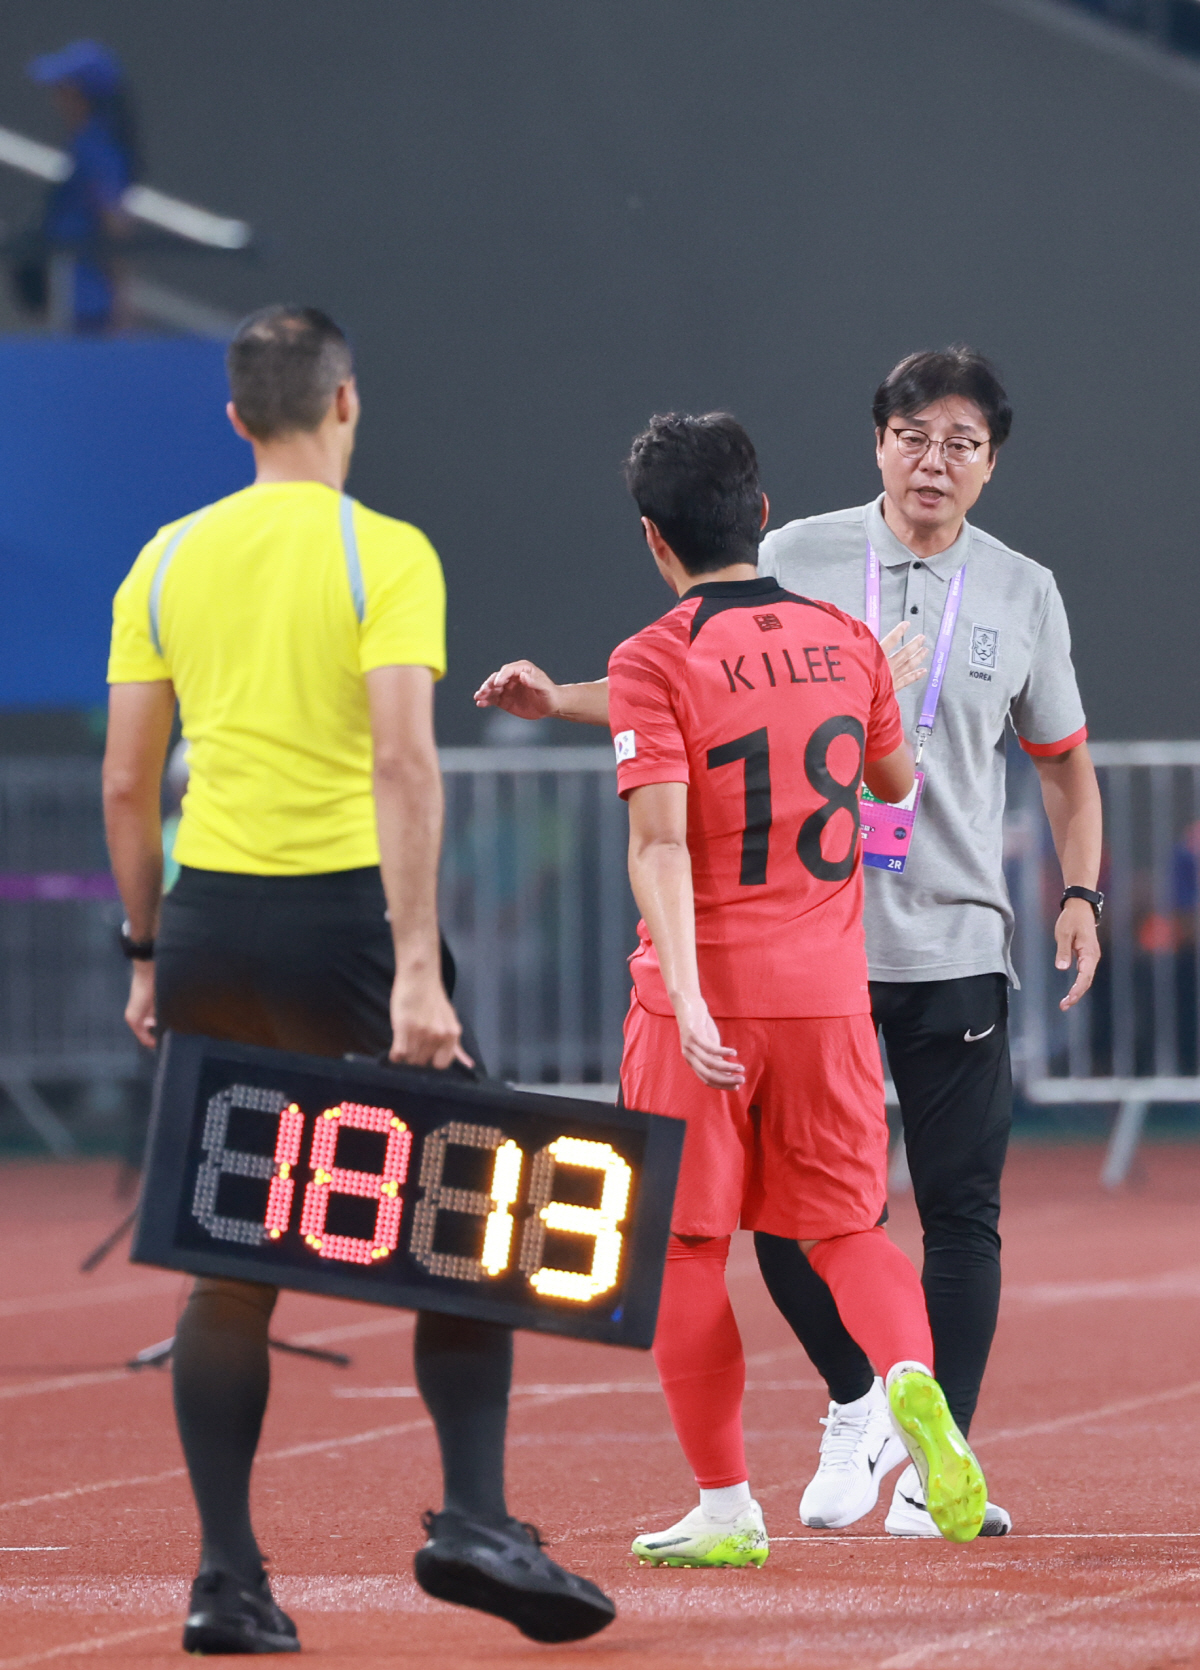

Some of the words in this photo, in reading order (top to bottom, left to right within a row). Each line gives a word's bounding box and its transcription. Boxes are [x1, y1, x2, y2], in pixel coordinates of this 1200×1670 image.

[969, 670, 992, 682] KOREA
[706, 714, 865, 886] 18
[887, 858, 903, 870] 2R
[263, 1101, 413, 1265] 18
[481, 1135, 632, 1303] 13
